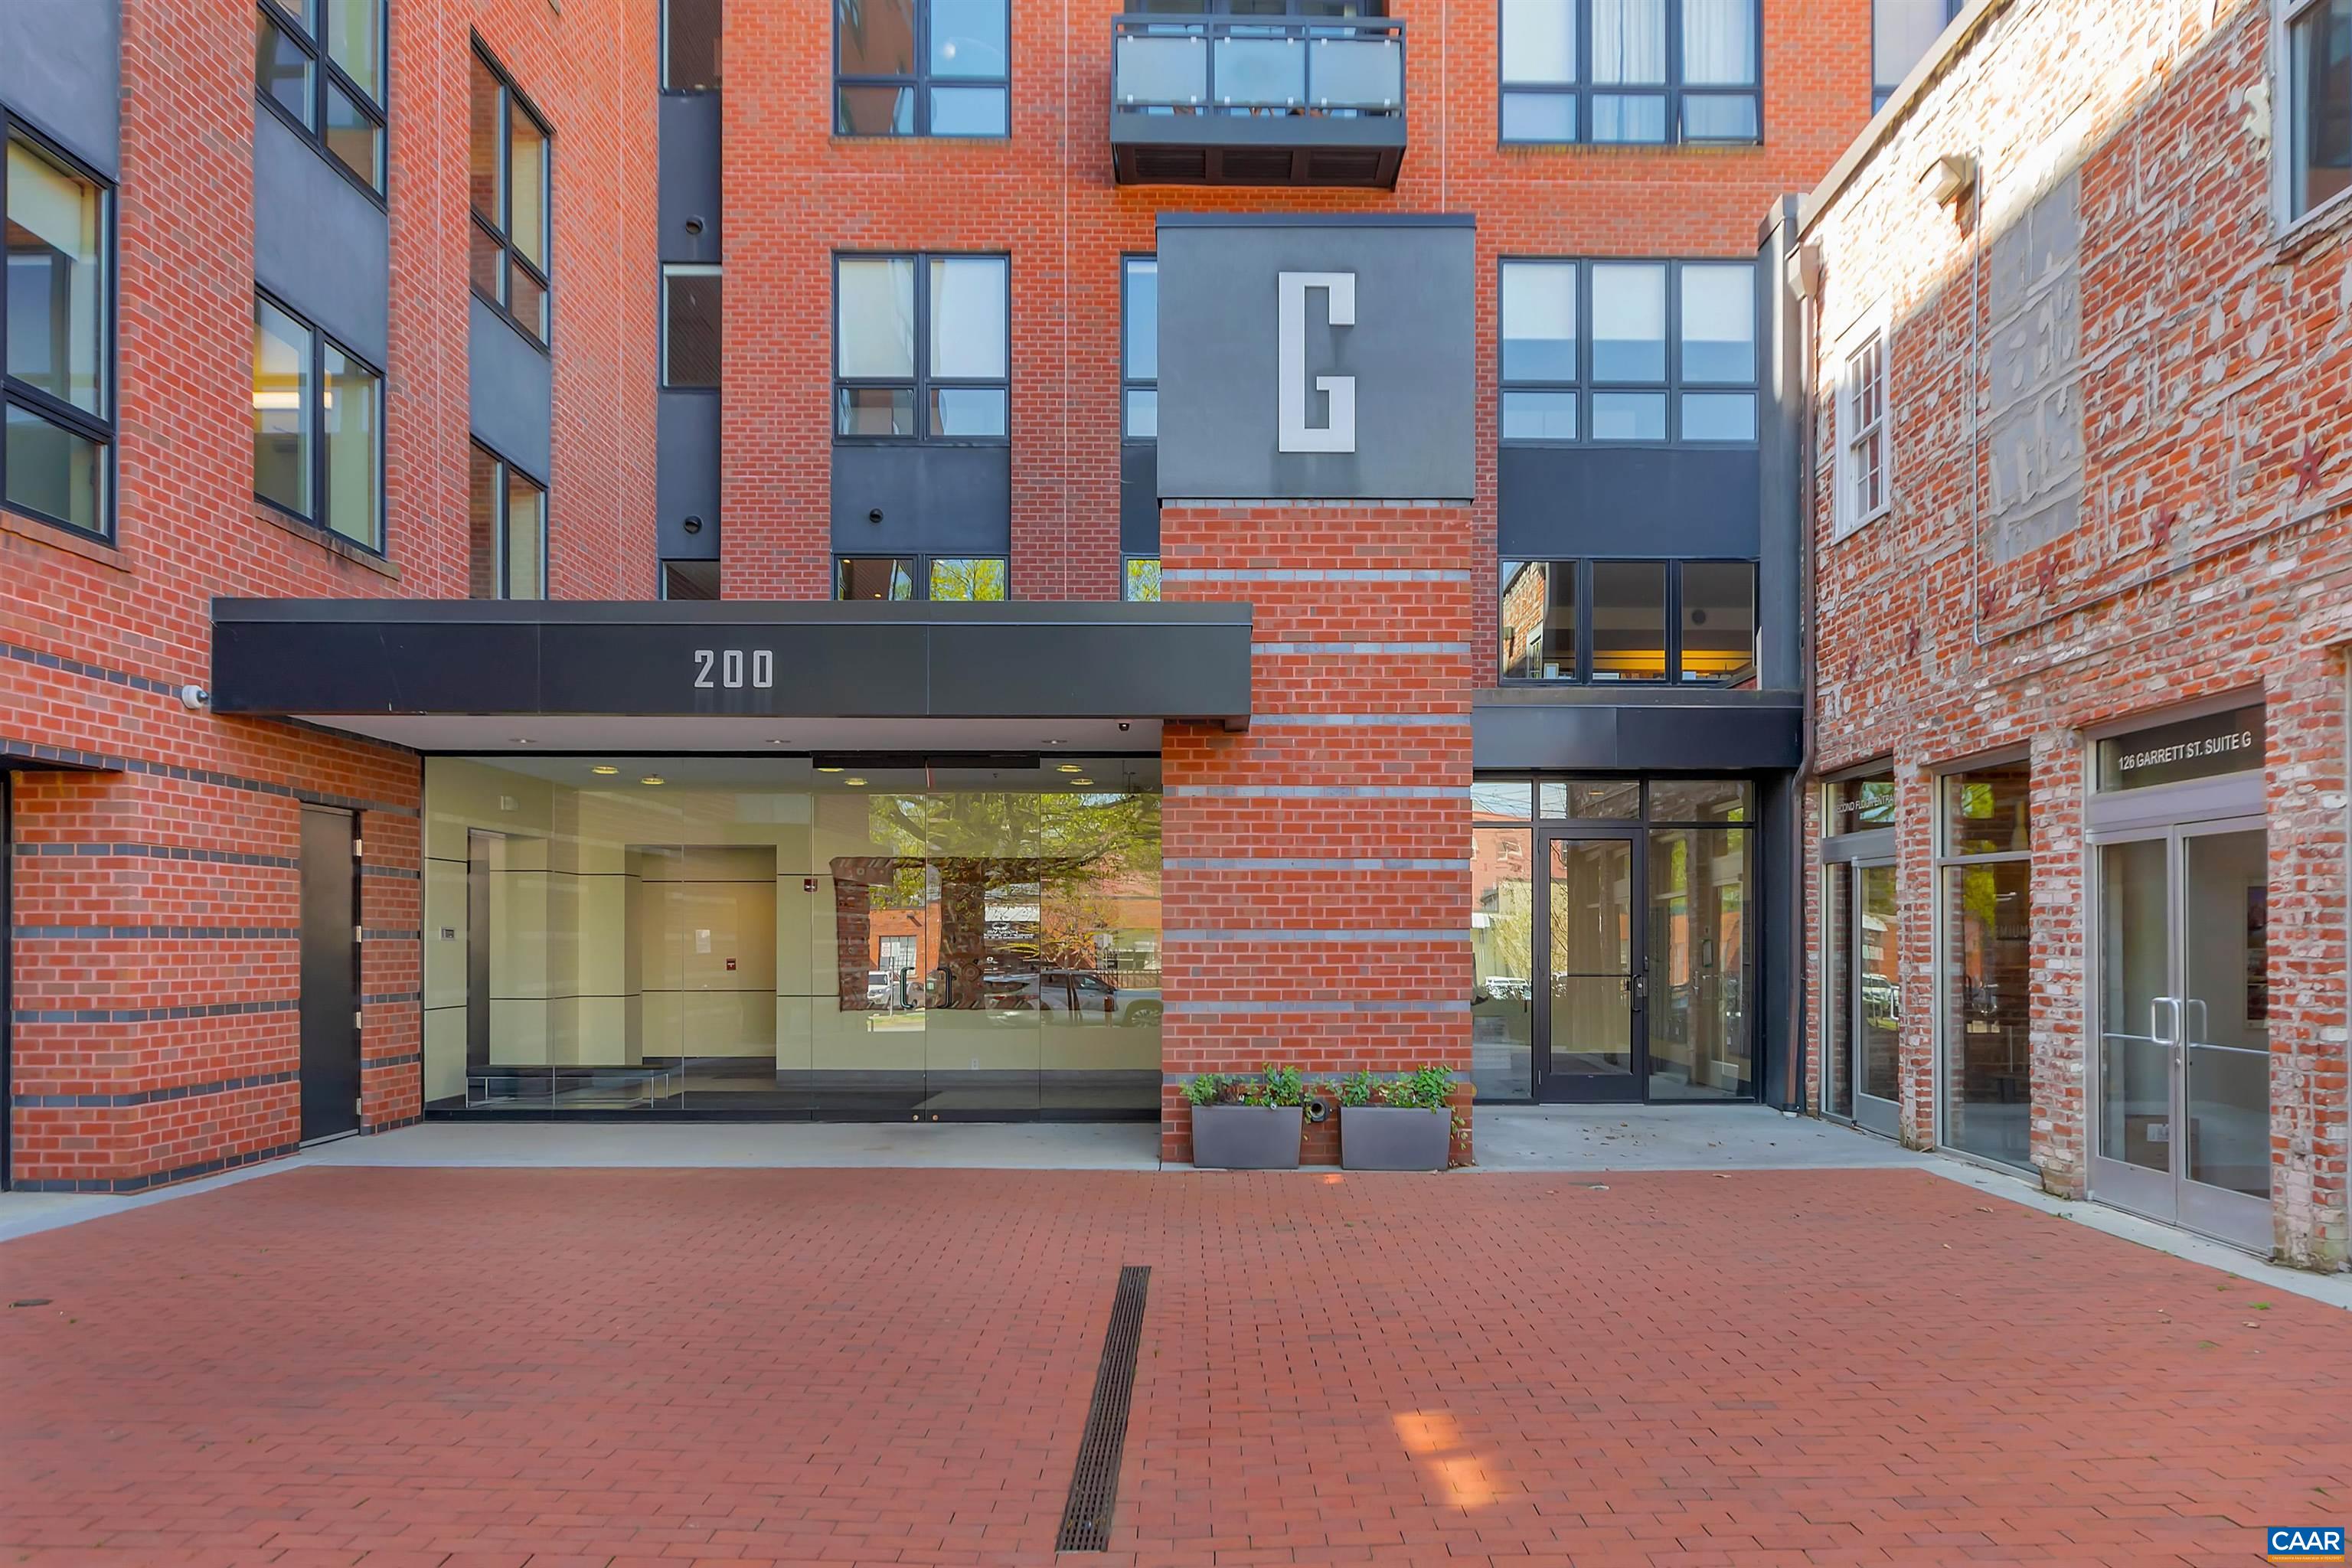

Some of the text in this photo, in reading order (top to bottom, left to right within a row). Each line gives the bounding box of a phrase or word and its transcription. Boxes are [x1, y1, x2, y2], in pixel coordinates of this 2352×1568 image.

[1279, 272, 1355, 452] G
[694, 649, 773, 688] 200
[2118, 730, 2252, 770] 126 GARRETT ST. SUITE G
